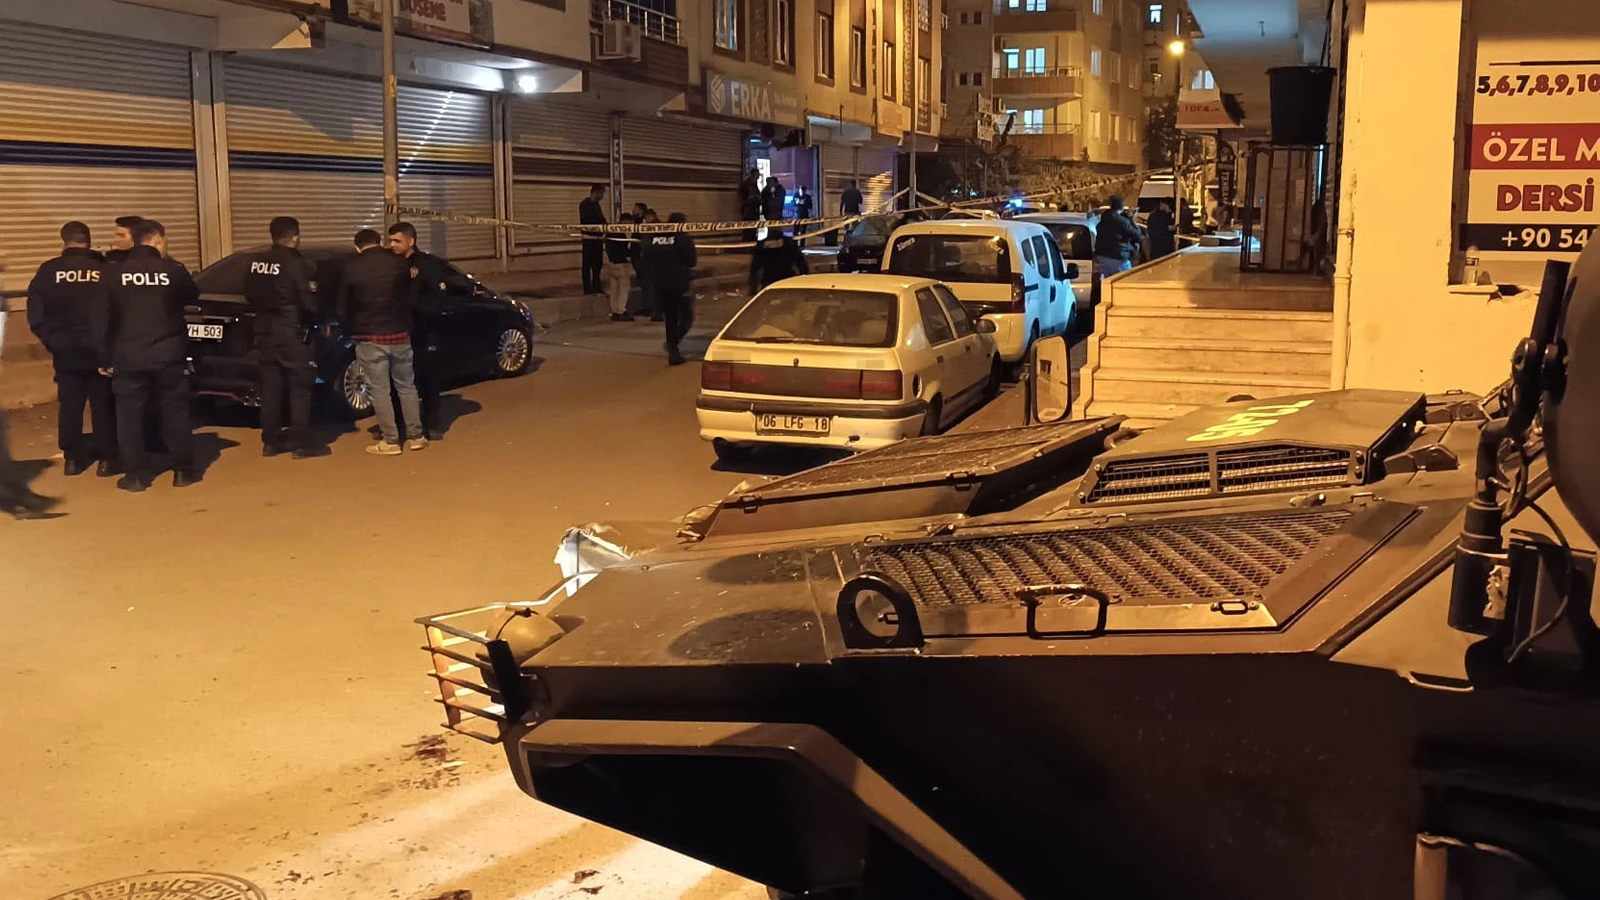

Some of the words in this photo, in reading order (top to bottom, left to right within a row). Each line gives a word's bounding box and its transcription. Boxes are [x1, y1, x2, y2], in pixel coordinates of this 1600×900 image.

[731, 81, 771, 120] ERKA
[1483, 131, 1566, 162] ÖZEL
[1496, 177, 1595, 212] DERSİ
[1502, 228, 1551, 248] +90
[204, 325, 222, 337] 503
[763, 414, 776, 427] 06
[784, 415, 804, 429] LFG
[814, 417, 828, 430] 18
